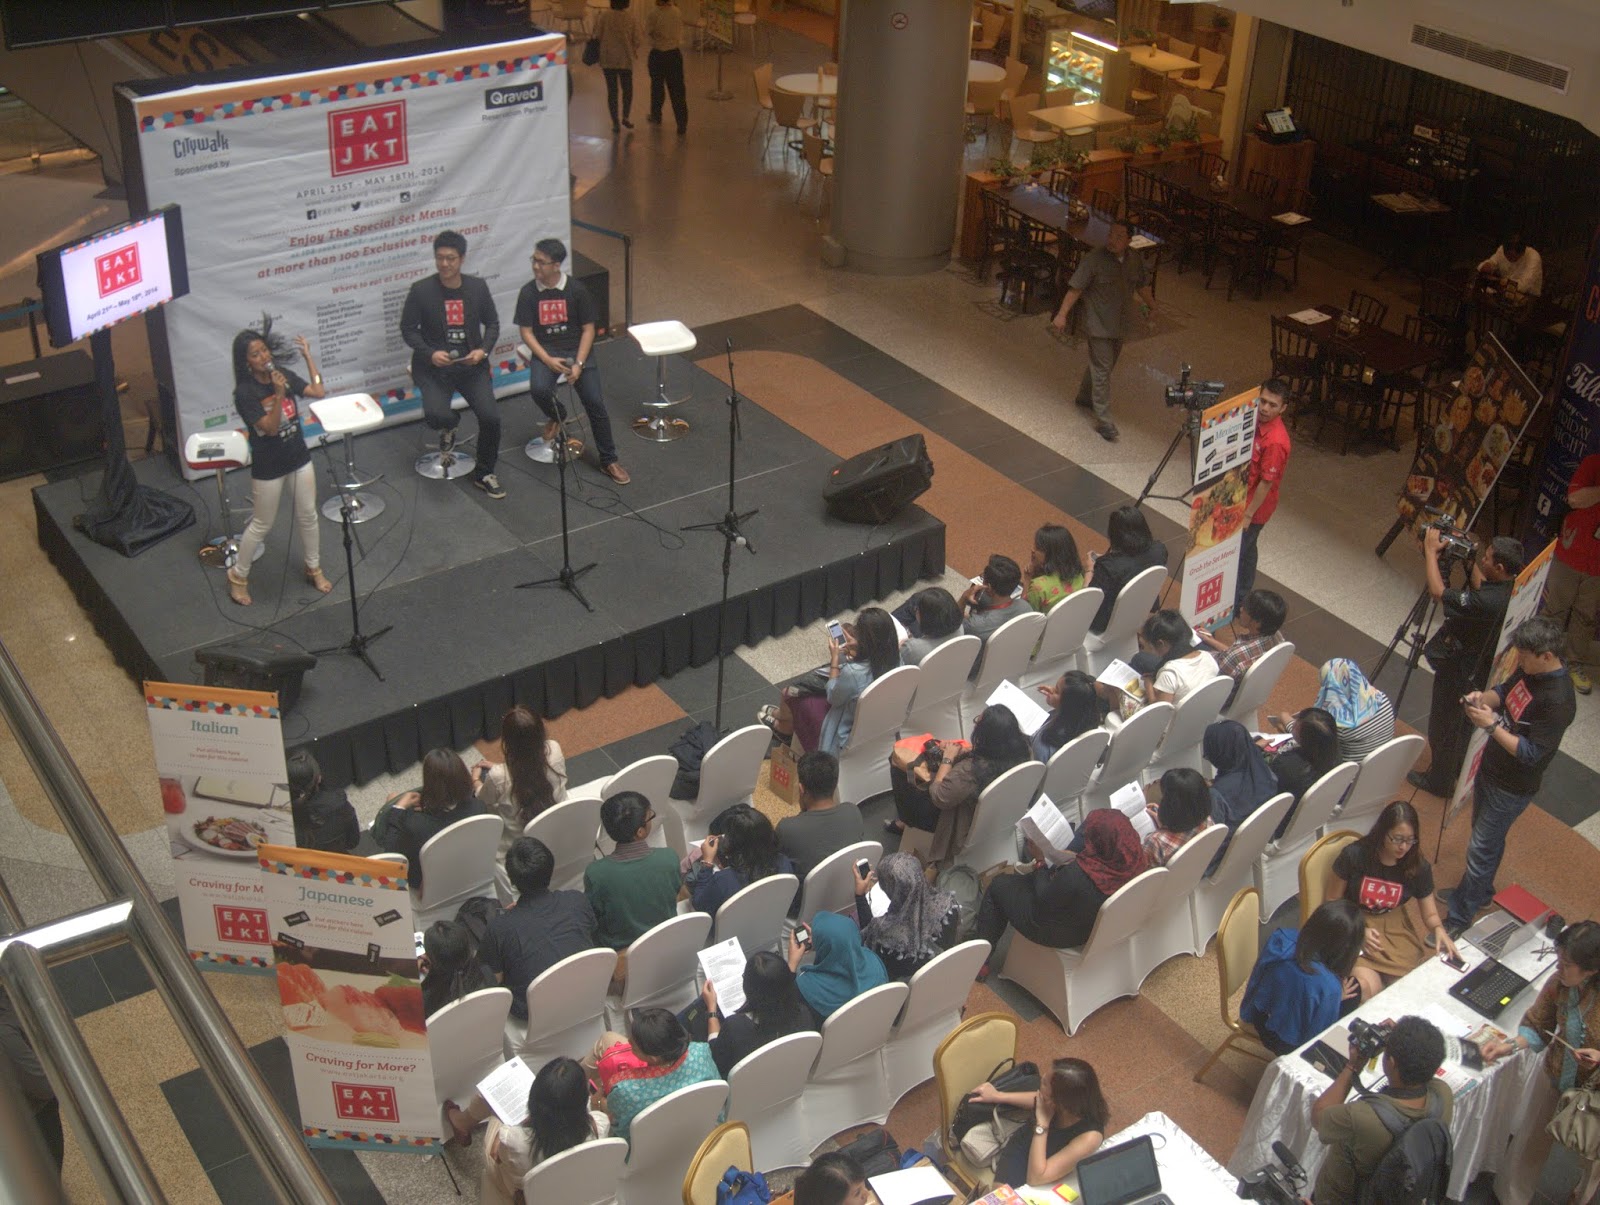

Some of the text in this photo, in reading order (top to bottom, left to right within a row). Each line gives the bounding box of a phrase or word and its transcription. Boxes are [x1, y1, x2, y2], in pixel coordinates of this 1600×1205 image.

[490, 86, 538, 105] Qraved
[340, 111, 397, 137] EAT
[340, 138, 398, 165] JKT
[174, 160, 230, 176] Sponsored by
[296, 187, 326, 199] APRIL
[330, 182, 354, 193] 21ST
[364, 175, 386, 186] MAY
[421, 165, 445, 177] 2014
[289, 233, 324, 248] Enjoy
[328, 228, 350, 240] The
[353, 217, 395, 234] Special
[398, 213, 416, 225] Set
[419, 207, 457, 222] Menus
[103, 250, 134, 271] EAT
[257, 268, 270, 279] at
[274, 261, 305, 275] more
[308, 255, 337, 268] than
[340, 250, 359, 261] 100
[362, 238, 416, 256] Exclusive
[104, 267, 136, 290] JKT
[332, 283, 358, 294] Where
[359, 280, 367, 288] to
[369, 278, 382, 286] eat
[87, 309, 101, 320] April
[118, 300, 130, 309] May
[145, 287, 158, 296] 2014
[543, 303, 562, 311] EAT
[1215, 422, 1242, 441] Mexican
[1201, 578, 1220, 595] EAT
[1199, 592, 1219, 608] JKT
[191, 720, 239, 735] Italian
[189, 878, 232, 892] Craving
[234, 882, 250, 892] for
[1367, 882, 1398, 897] EAT
[298, 886, 374, 908] Japanese
[223, 911, 262, 924] EAT
[224, 927, 264, 939] JKT
[306, 1052, 416, 1072] Craving for More?
[343, 1088, 387, 1101] EAT
[345, 1104, 390, 1116] JKT
